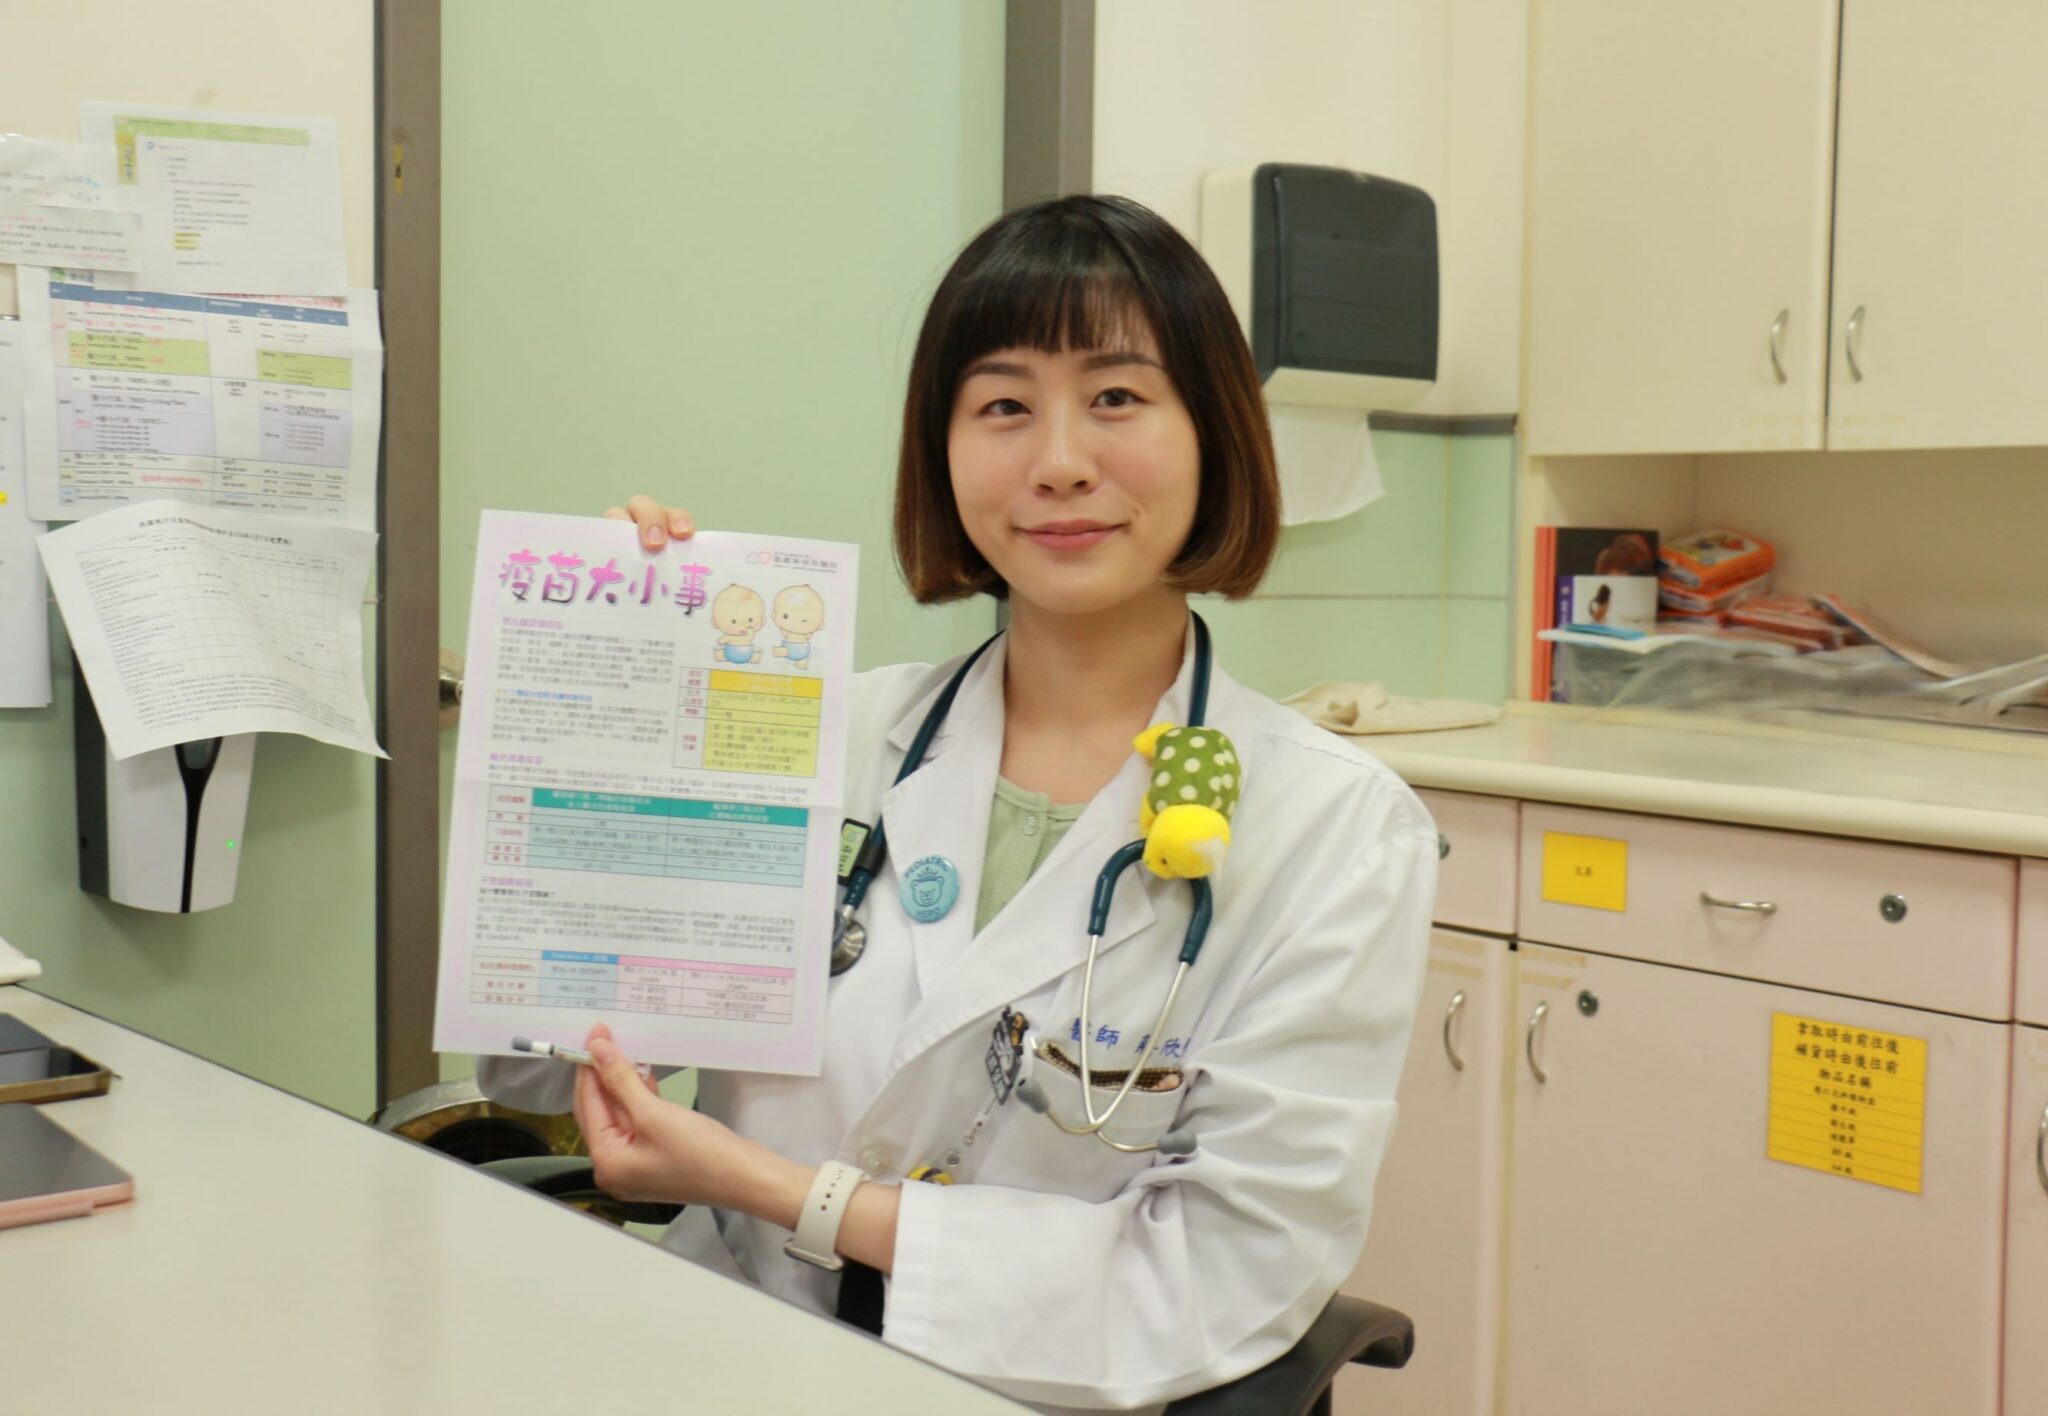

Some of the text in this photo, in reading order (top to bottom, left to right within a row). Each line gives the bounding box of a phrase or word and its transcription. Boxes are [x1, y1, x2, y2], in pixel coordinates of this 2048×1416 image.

[499, 548, 712, 617] 疫苗大小事
[1797, 1021, 1900, 1055] 拿取時由前往後
[1818, 1068, 1872, 1090] 物品名稱
